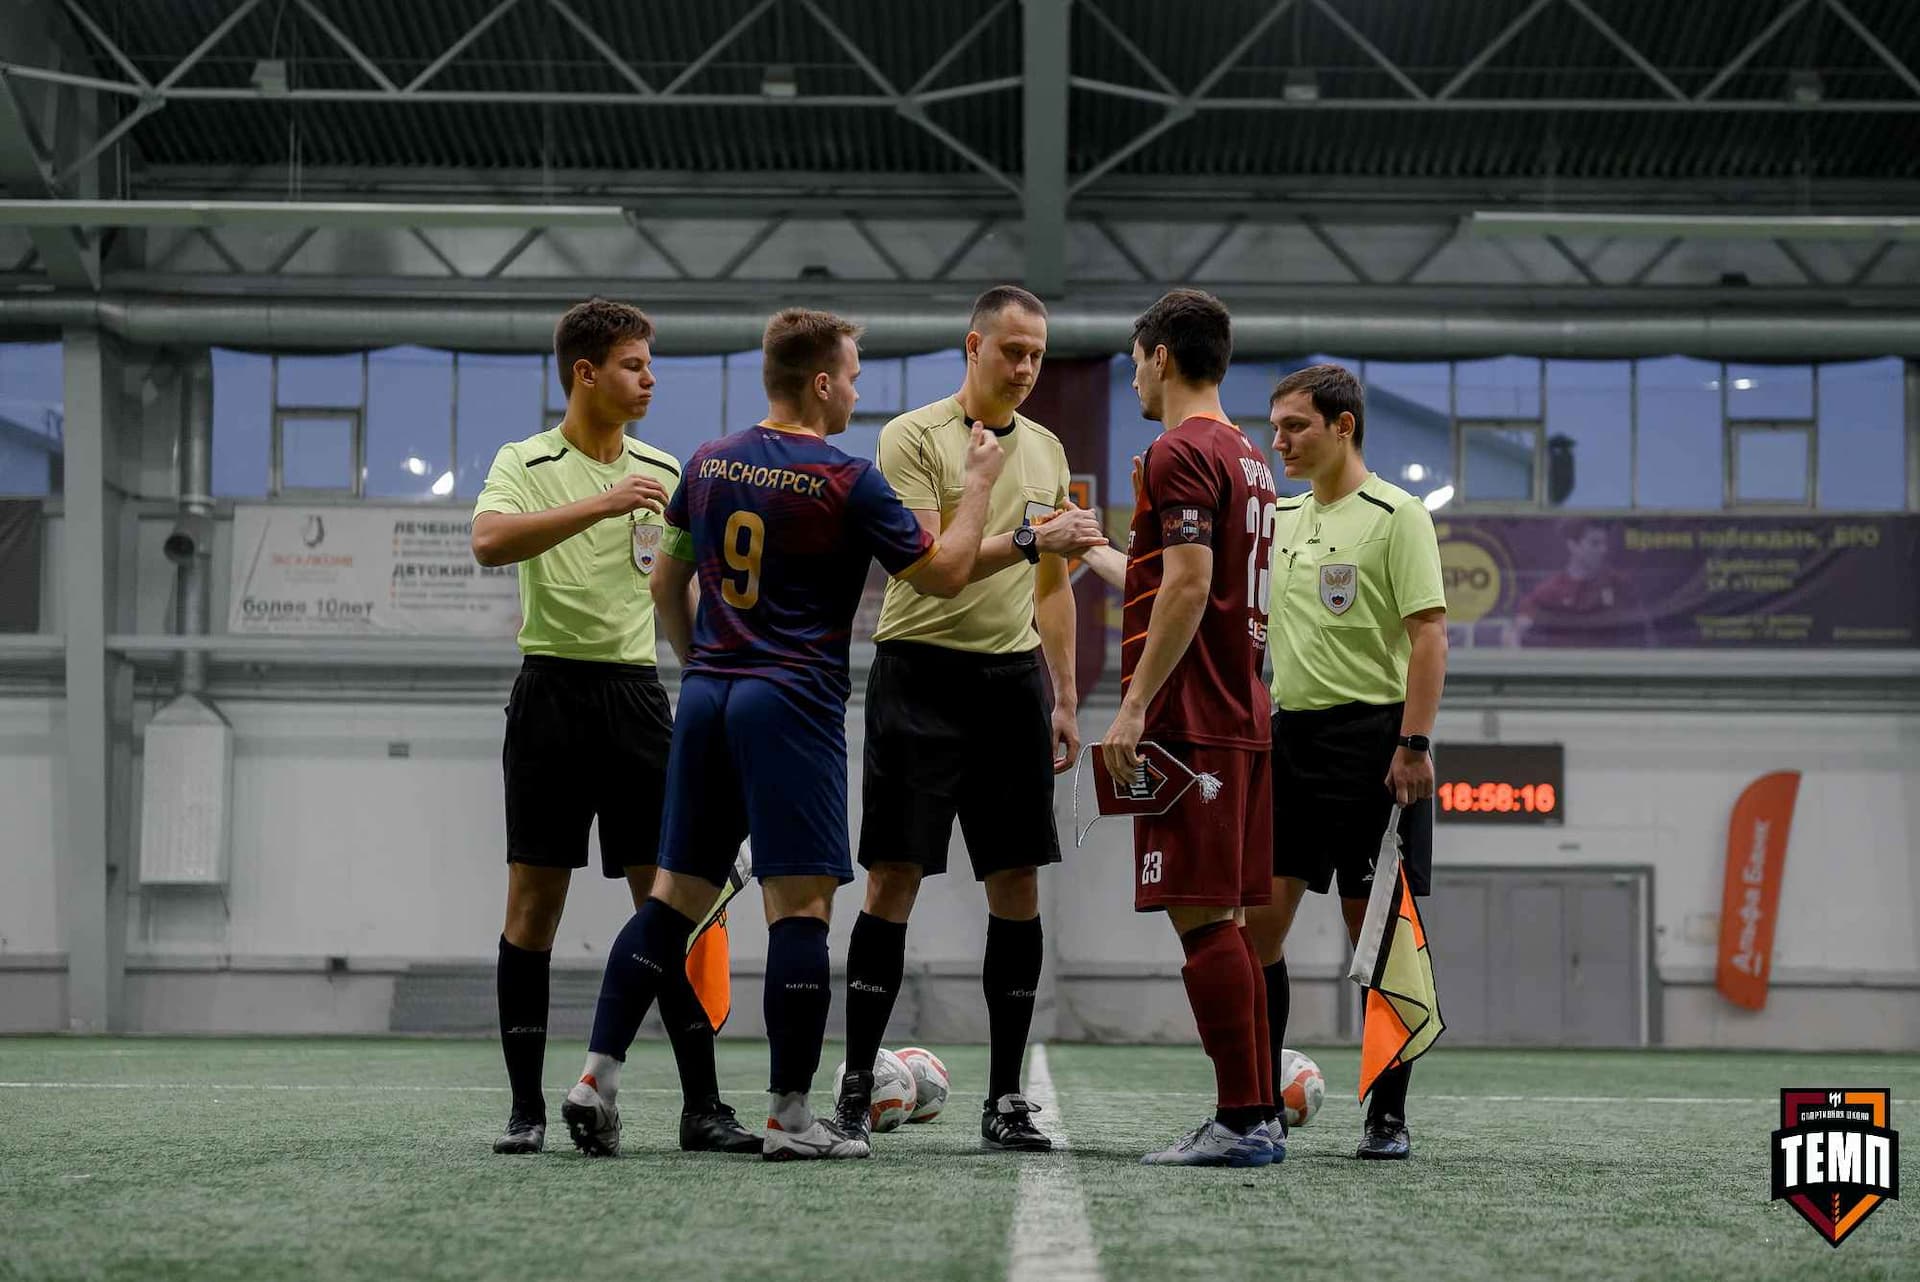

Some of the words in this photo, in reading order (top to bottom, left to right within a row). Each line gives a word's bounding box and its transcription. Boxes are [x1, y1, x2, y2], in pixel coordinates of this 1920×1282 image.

[698, 458, 827, 496] КРАСНОЯРСК
[1182, 509, 1199, 521] 100
[392, 562, 475, 579] ДЕТСКИЙ
[721, 510, 765, 610] 9
[1246, 496, 1277, 616] 23
[243, 595, 307, 617] более
[1141, 850, 1163, 886] 23
